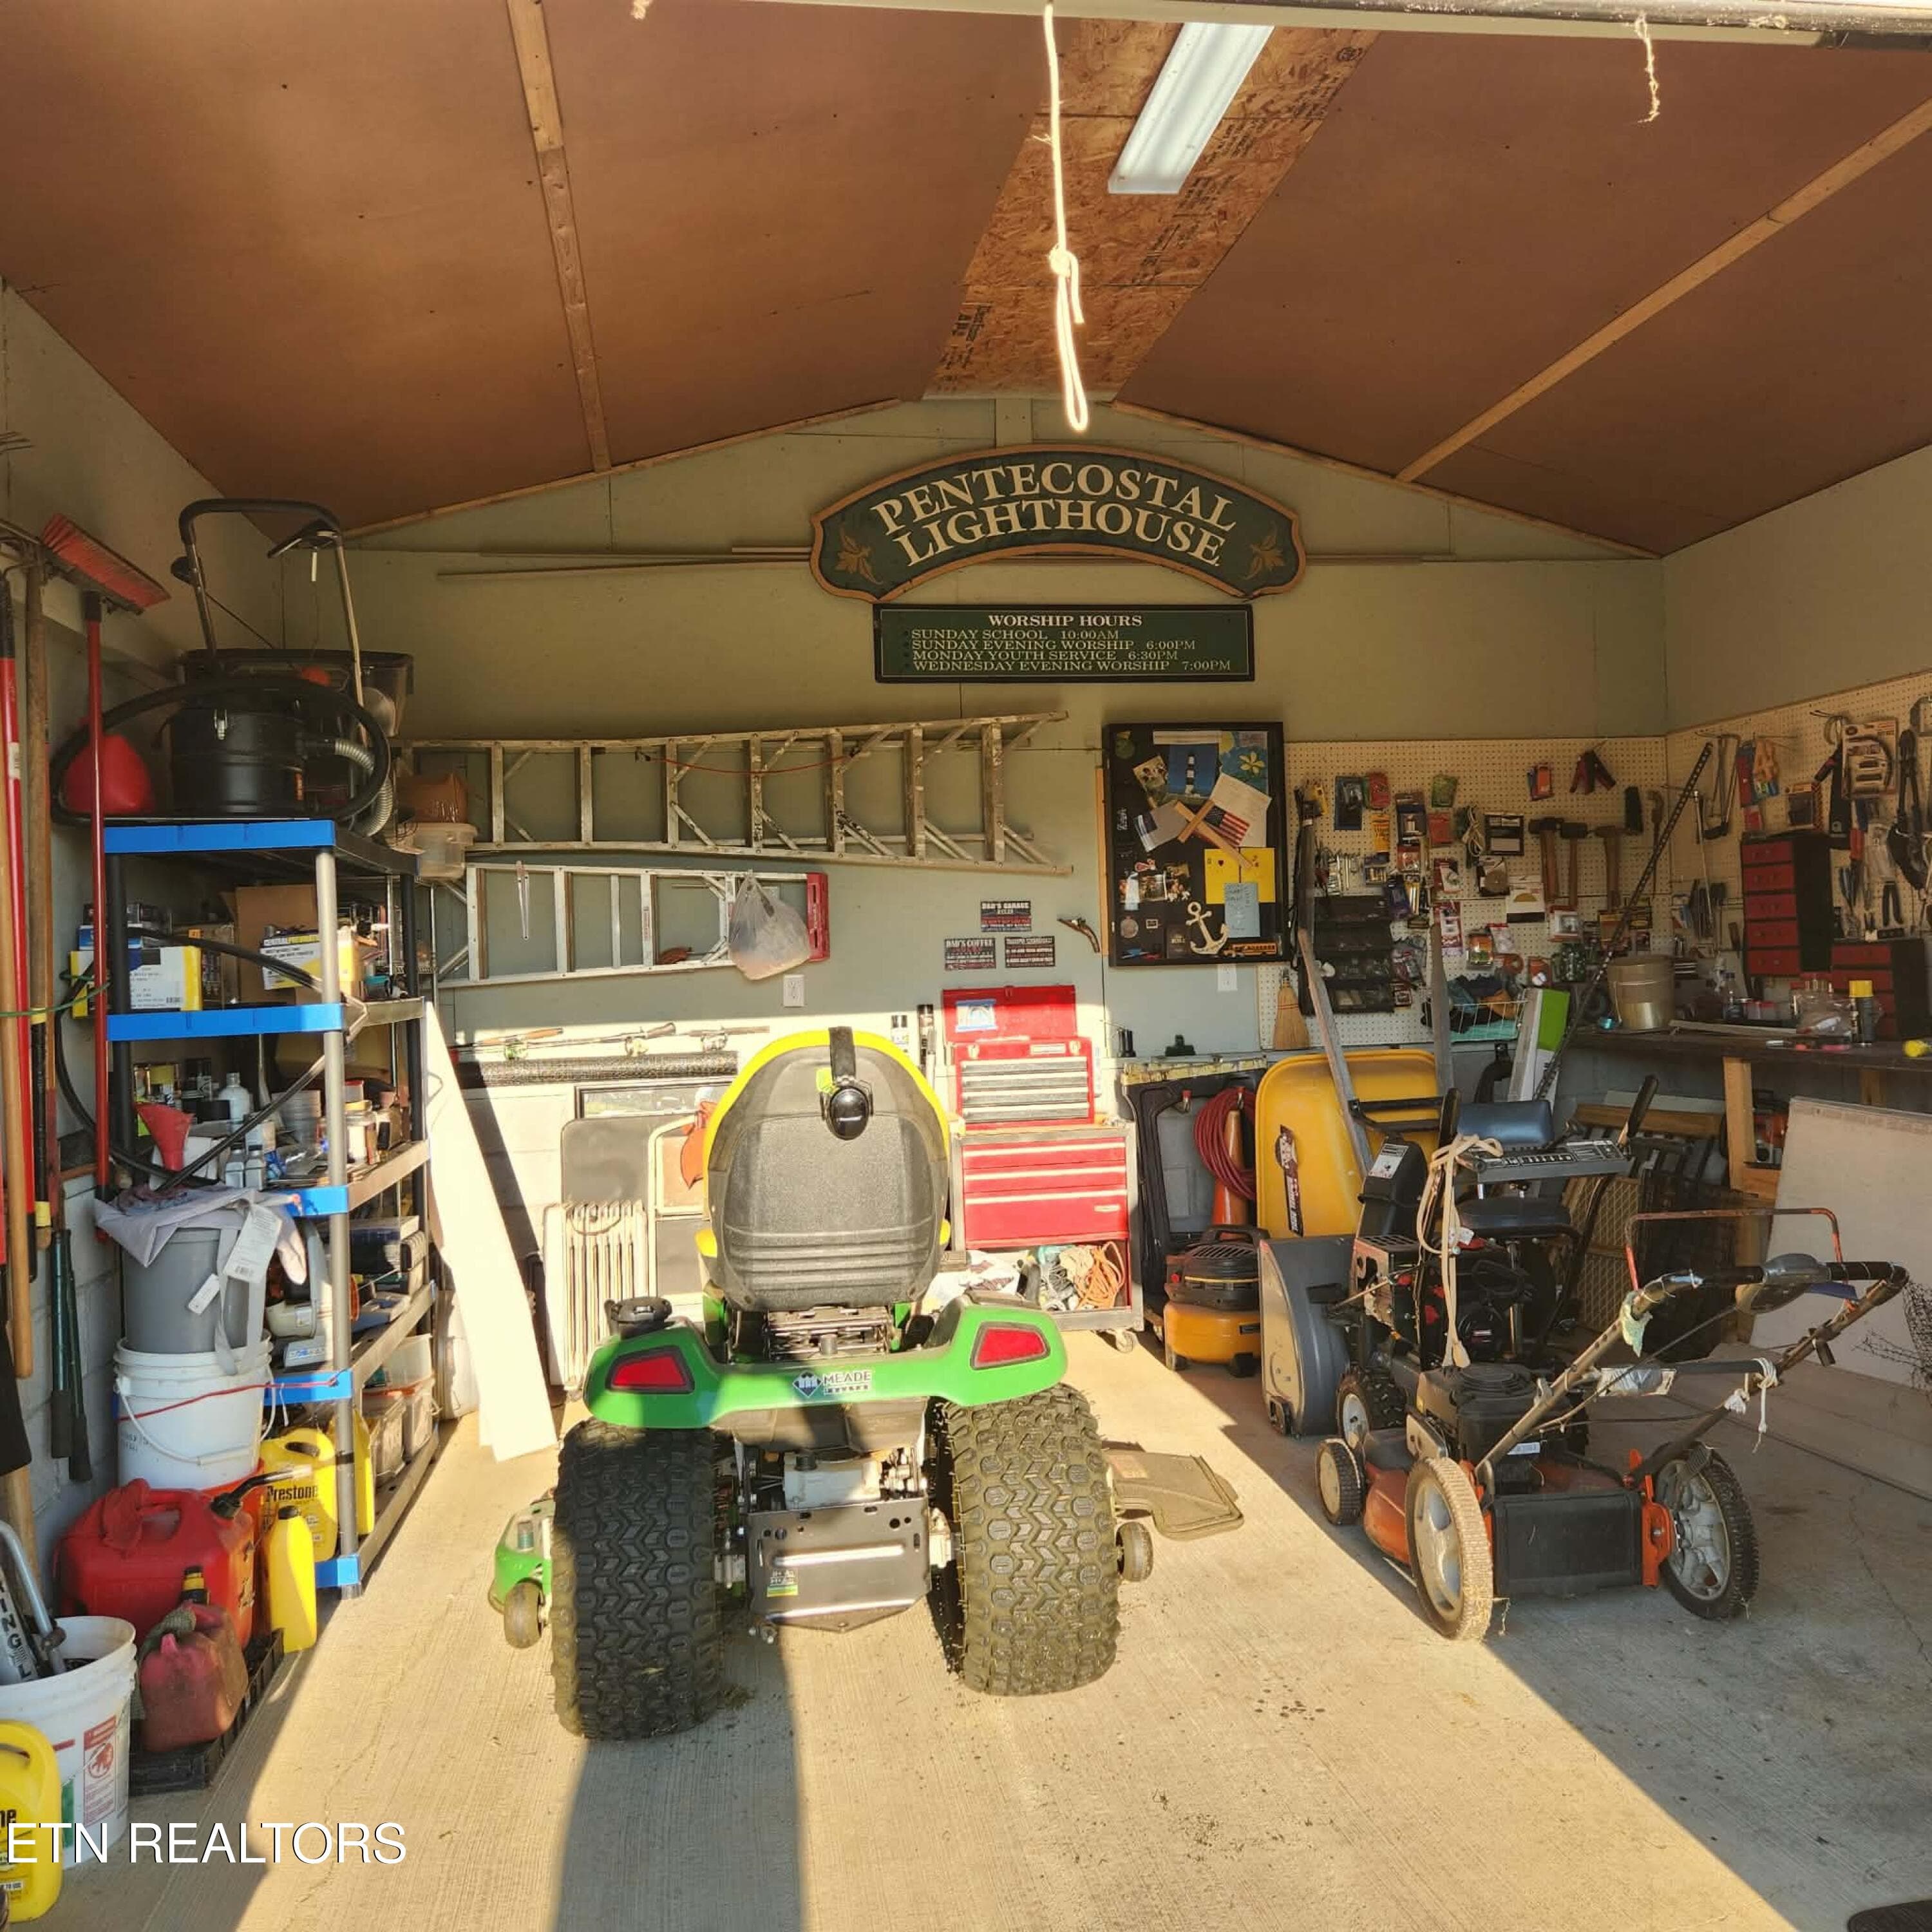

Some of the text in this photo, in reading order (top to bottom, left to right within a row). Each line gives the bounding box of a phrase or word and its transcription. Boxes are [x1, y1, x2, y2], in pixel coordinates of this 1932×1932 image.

[870, 462, 1236, 536] PENTECOSTAL
[893, 498, 1225, 567] LIGHTHOUSE
[989, 615, 1142, 627] WORSHIP HOURS
[911, 629, 1119, 640] SUNDAY SCHOOL 10:00AM
[911, 639, 1195, 650] SUNDAY EVENING WORSHIP 6:00PM
[913, 650, 1178, 660] MONDAY YOUTH SERVICE 6:30PM
[913, 660, 1231, 671] WEDNESDAY EVENING WORSHIP 7:00PM
[824, 1371, 871, 1384] MEADE
[267, 1484, 319, 1502] Prestone
